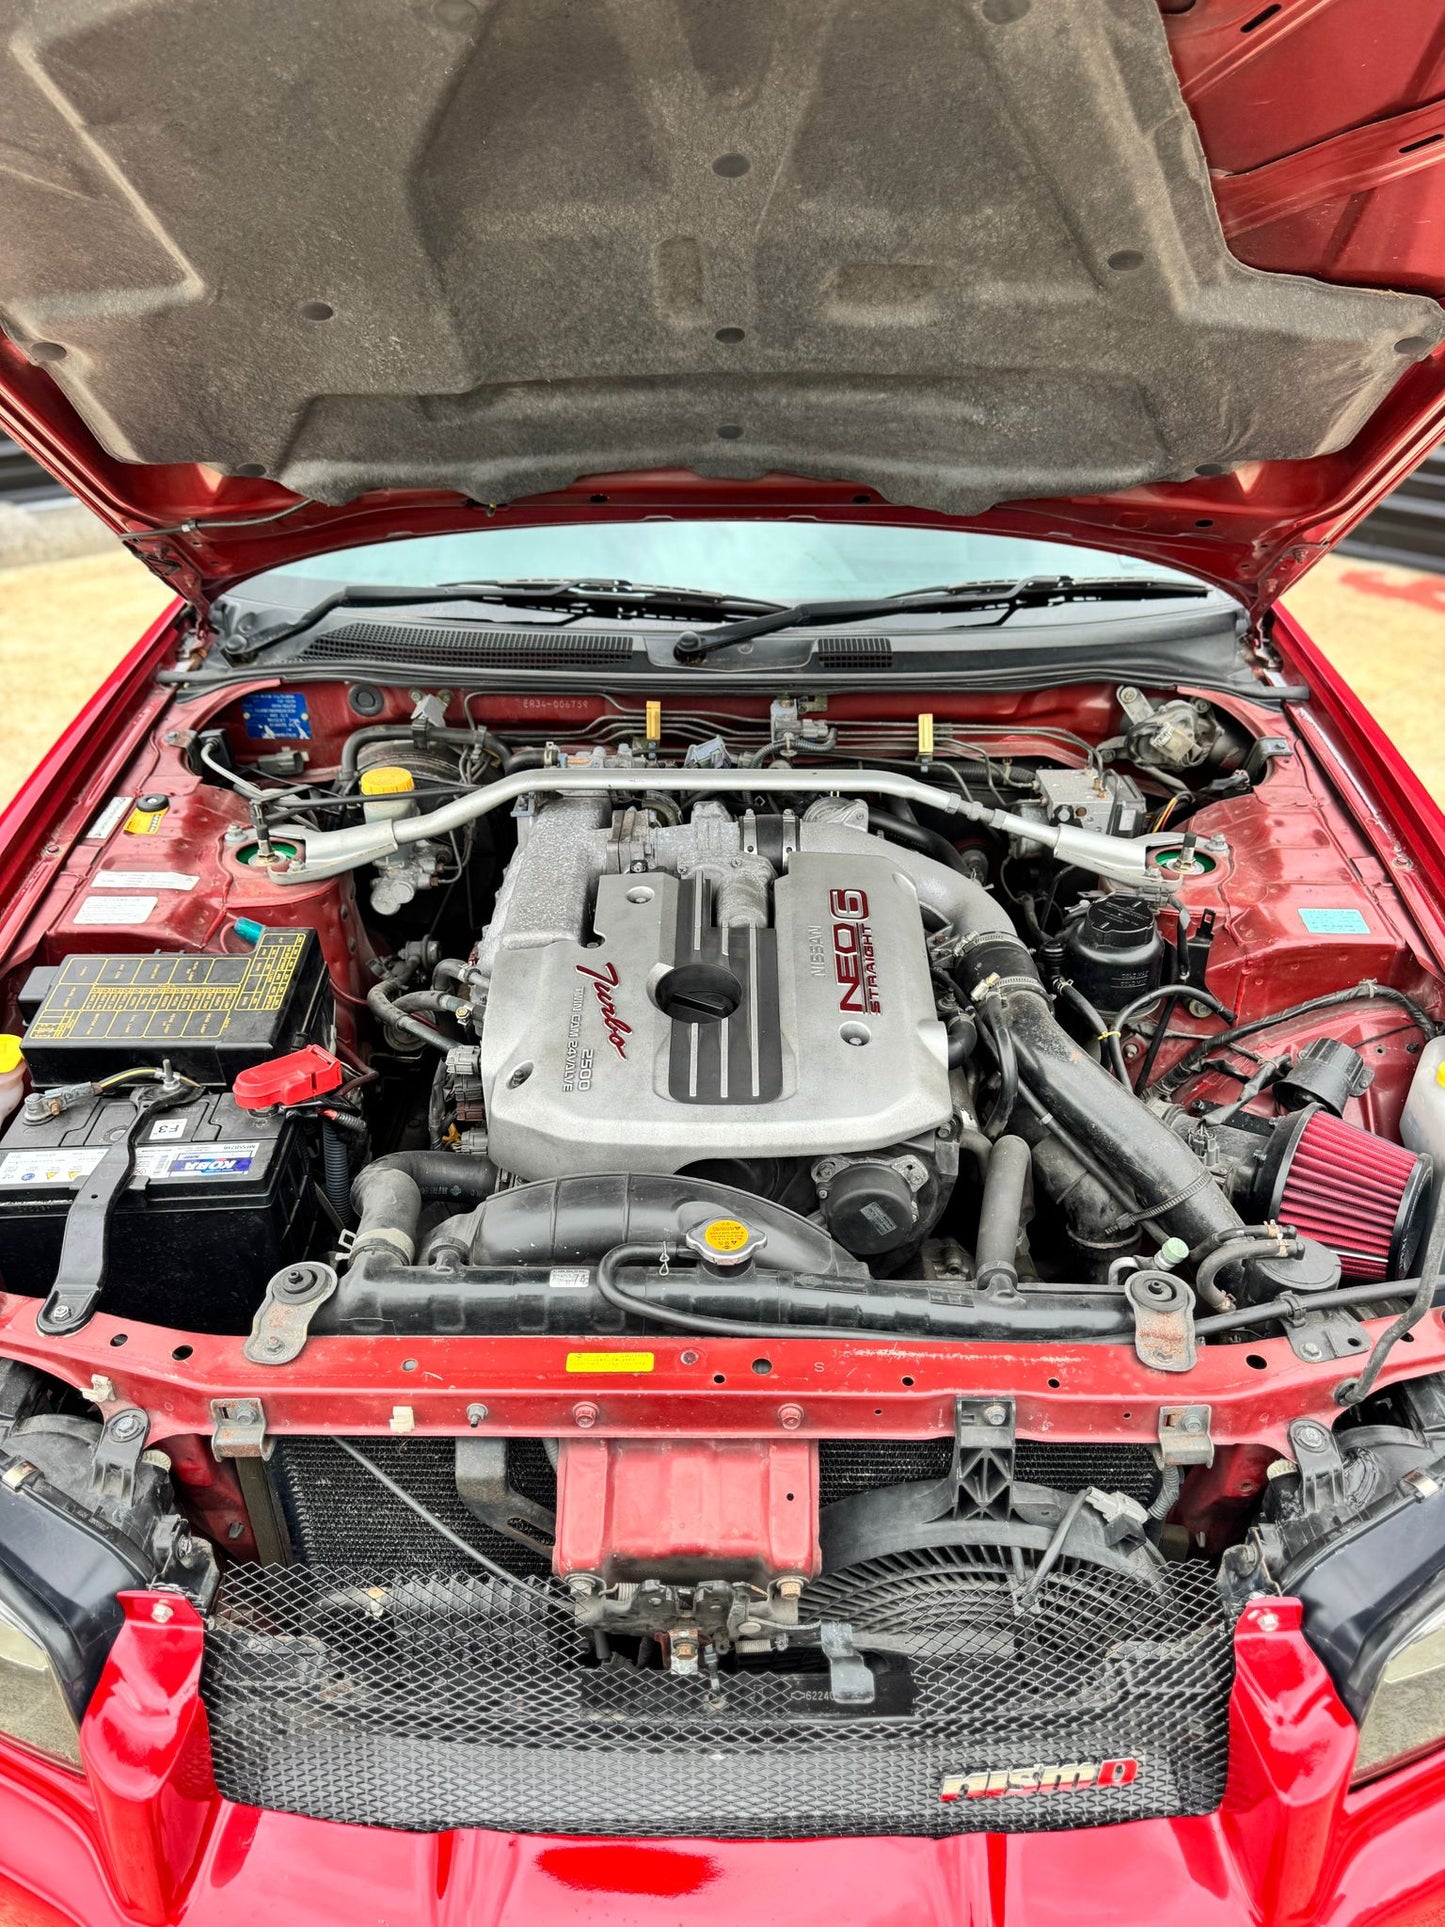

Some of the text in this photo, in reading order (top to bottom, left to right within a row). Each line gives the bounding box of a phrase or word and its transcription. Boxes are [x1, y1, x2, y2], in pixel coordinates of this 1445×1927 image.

[808, 925, 826, 978] NISSAN
[861, 923, 883, 1016] STRAIGHT
[575, 961, 633, 1062] Turbo
[562, 986, 585, 1093] TWIN CAM 24VALVE
[578, 1048, 594, 1092] 2500
[158, 1124, 179, 1134] F3
[183, 1160, 237, 1171] KOBA
